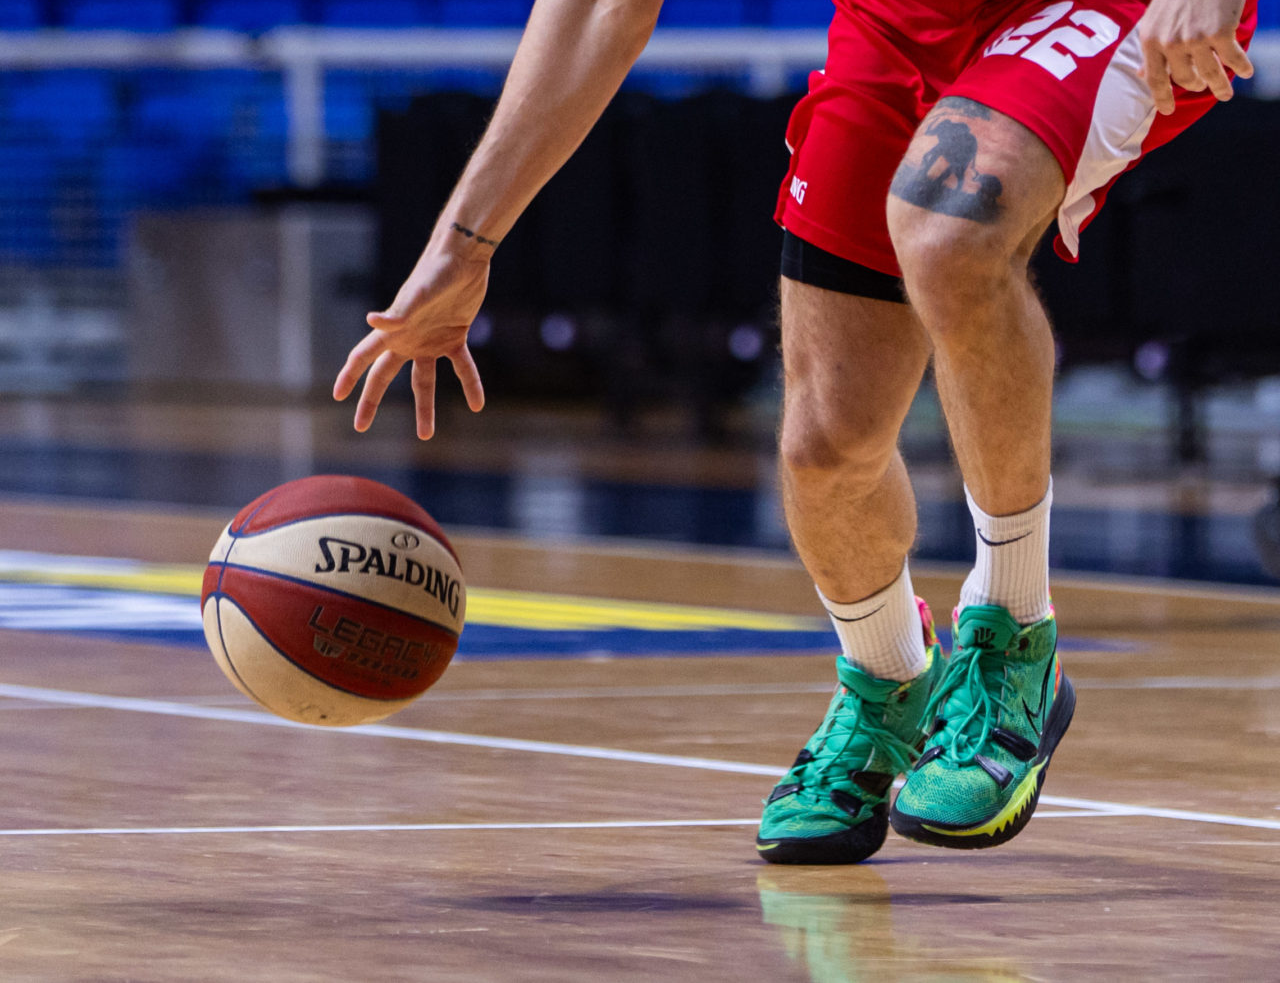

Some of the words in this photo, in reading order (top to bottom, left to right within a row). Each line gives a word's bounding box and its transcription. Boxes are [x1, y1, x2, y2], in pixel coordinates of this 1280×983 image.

[983, 0, 1121, 81] 22
[315, 537, 461, 618] SPALDING
[309, 605, 440, 666] LEGACY
